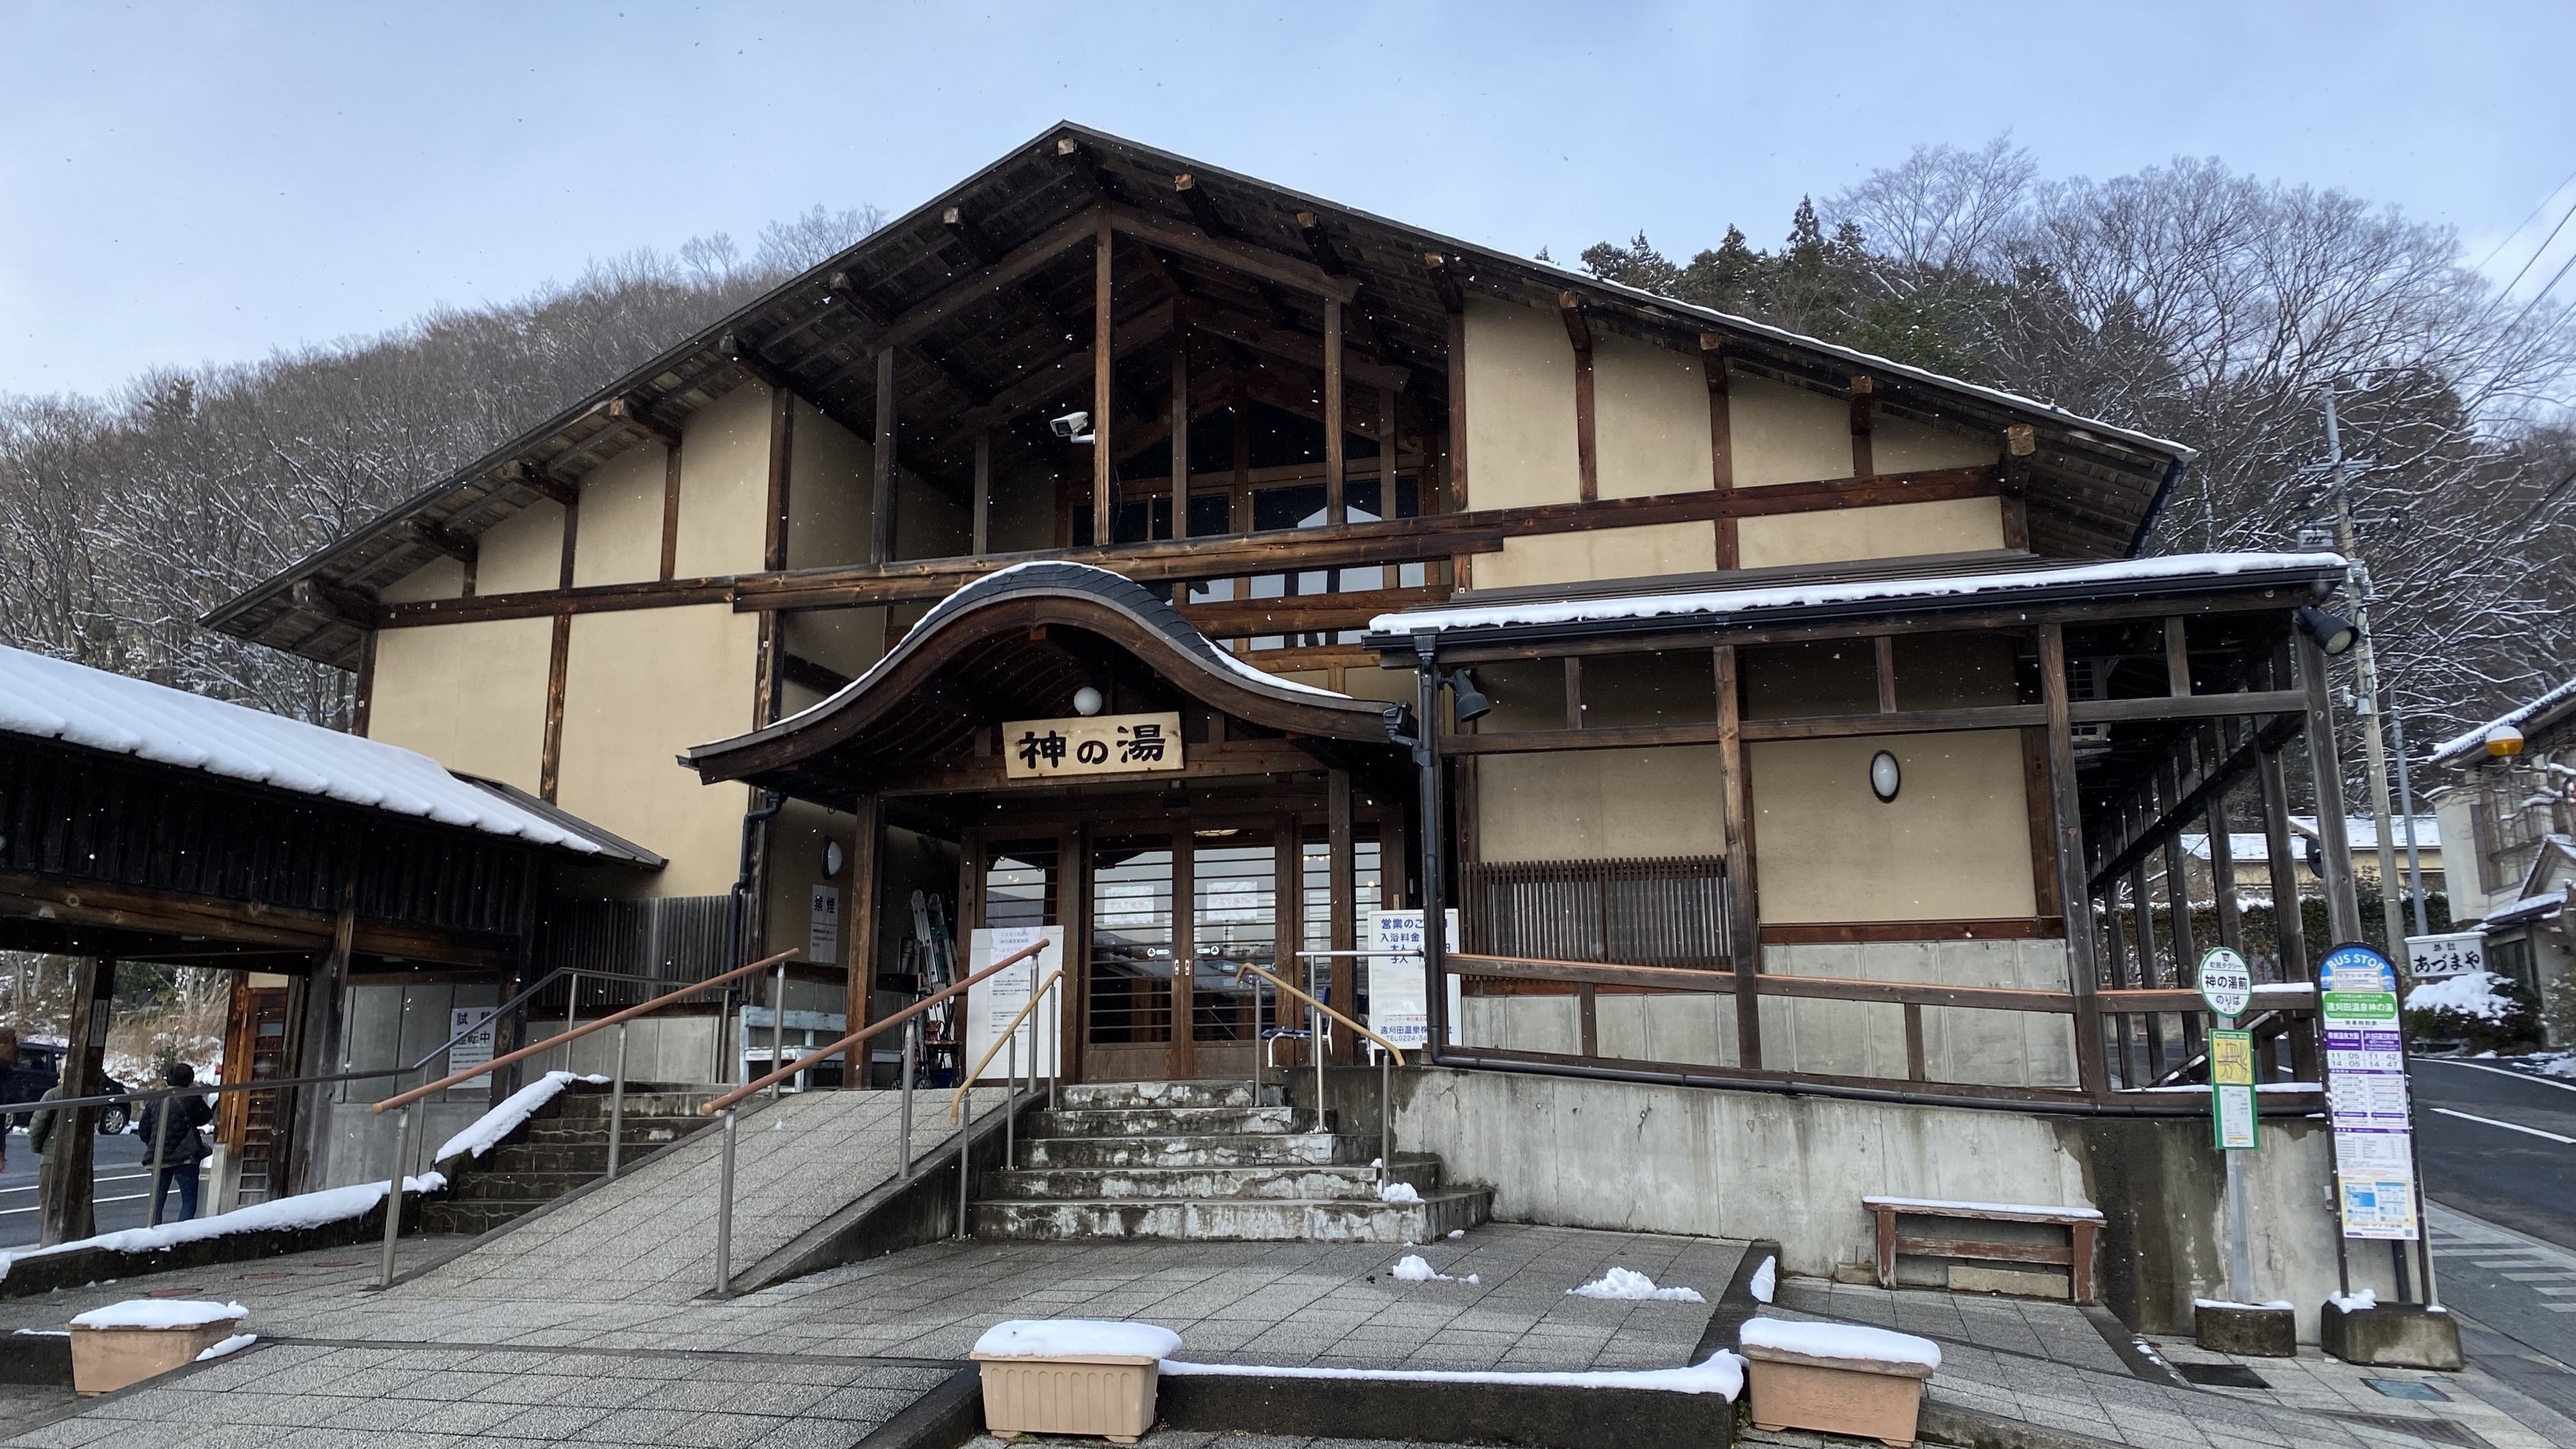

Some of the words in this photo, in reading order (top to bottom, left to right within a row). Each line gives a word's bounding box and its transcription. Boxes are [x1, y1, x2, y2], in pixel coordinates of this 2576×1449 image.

[1019, 724, 1166, 769] 神の湯
[814, 896, 836, 914] 禁煙
[1381, 933, 1420, 942] 入浴料金
[2327, 954, 2350, 970] BUS
[2353, 954, 2384, 970] STOP
[2414, 951, 2480, 972] あづまや
[2205, 974, 2247, 990] 神の湯前
[2216, 995, 2240, 1005] のりば
